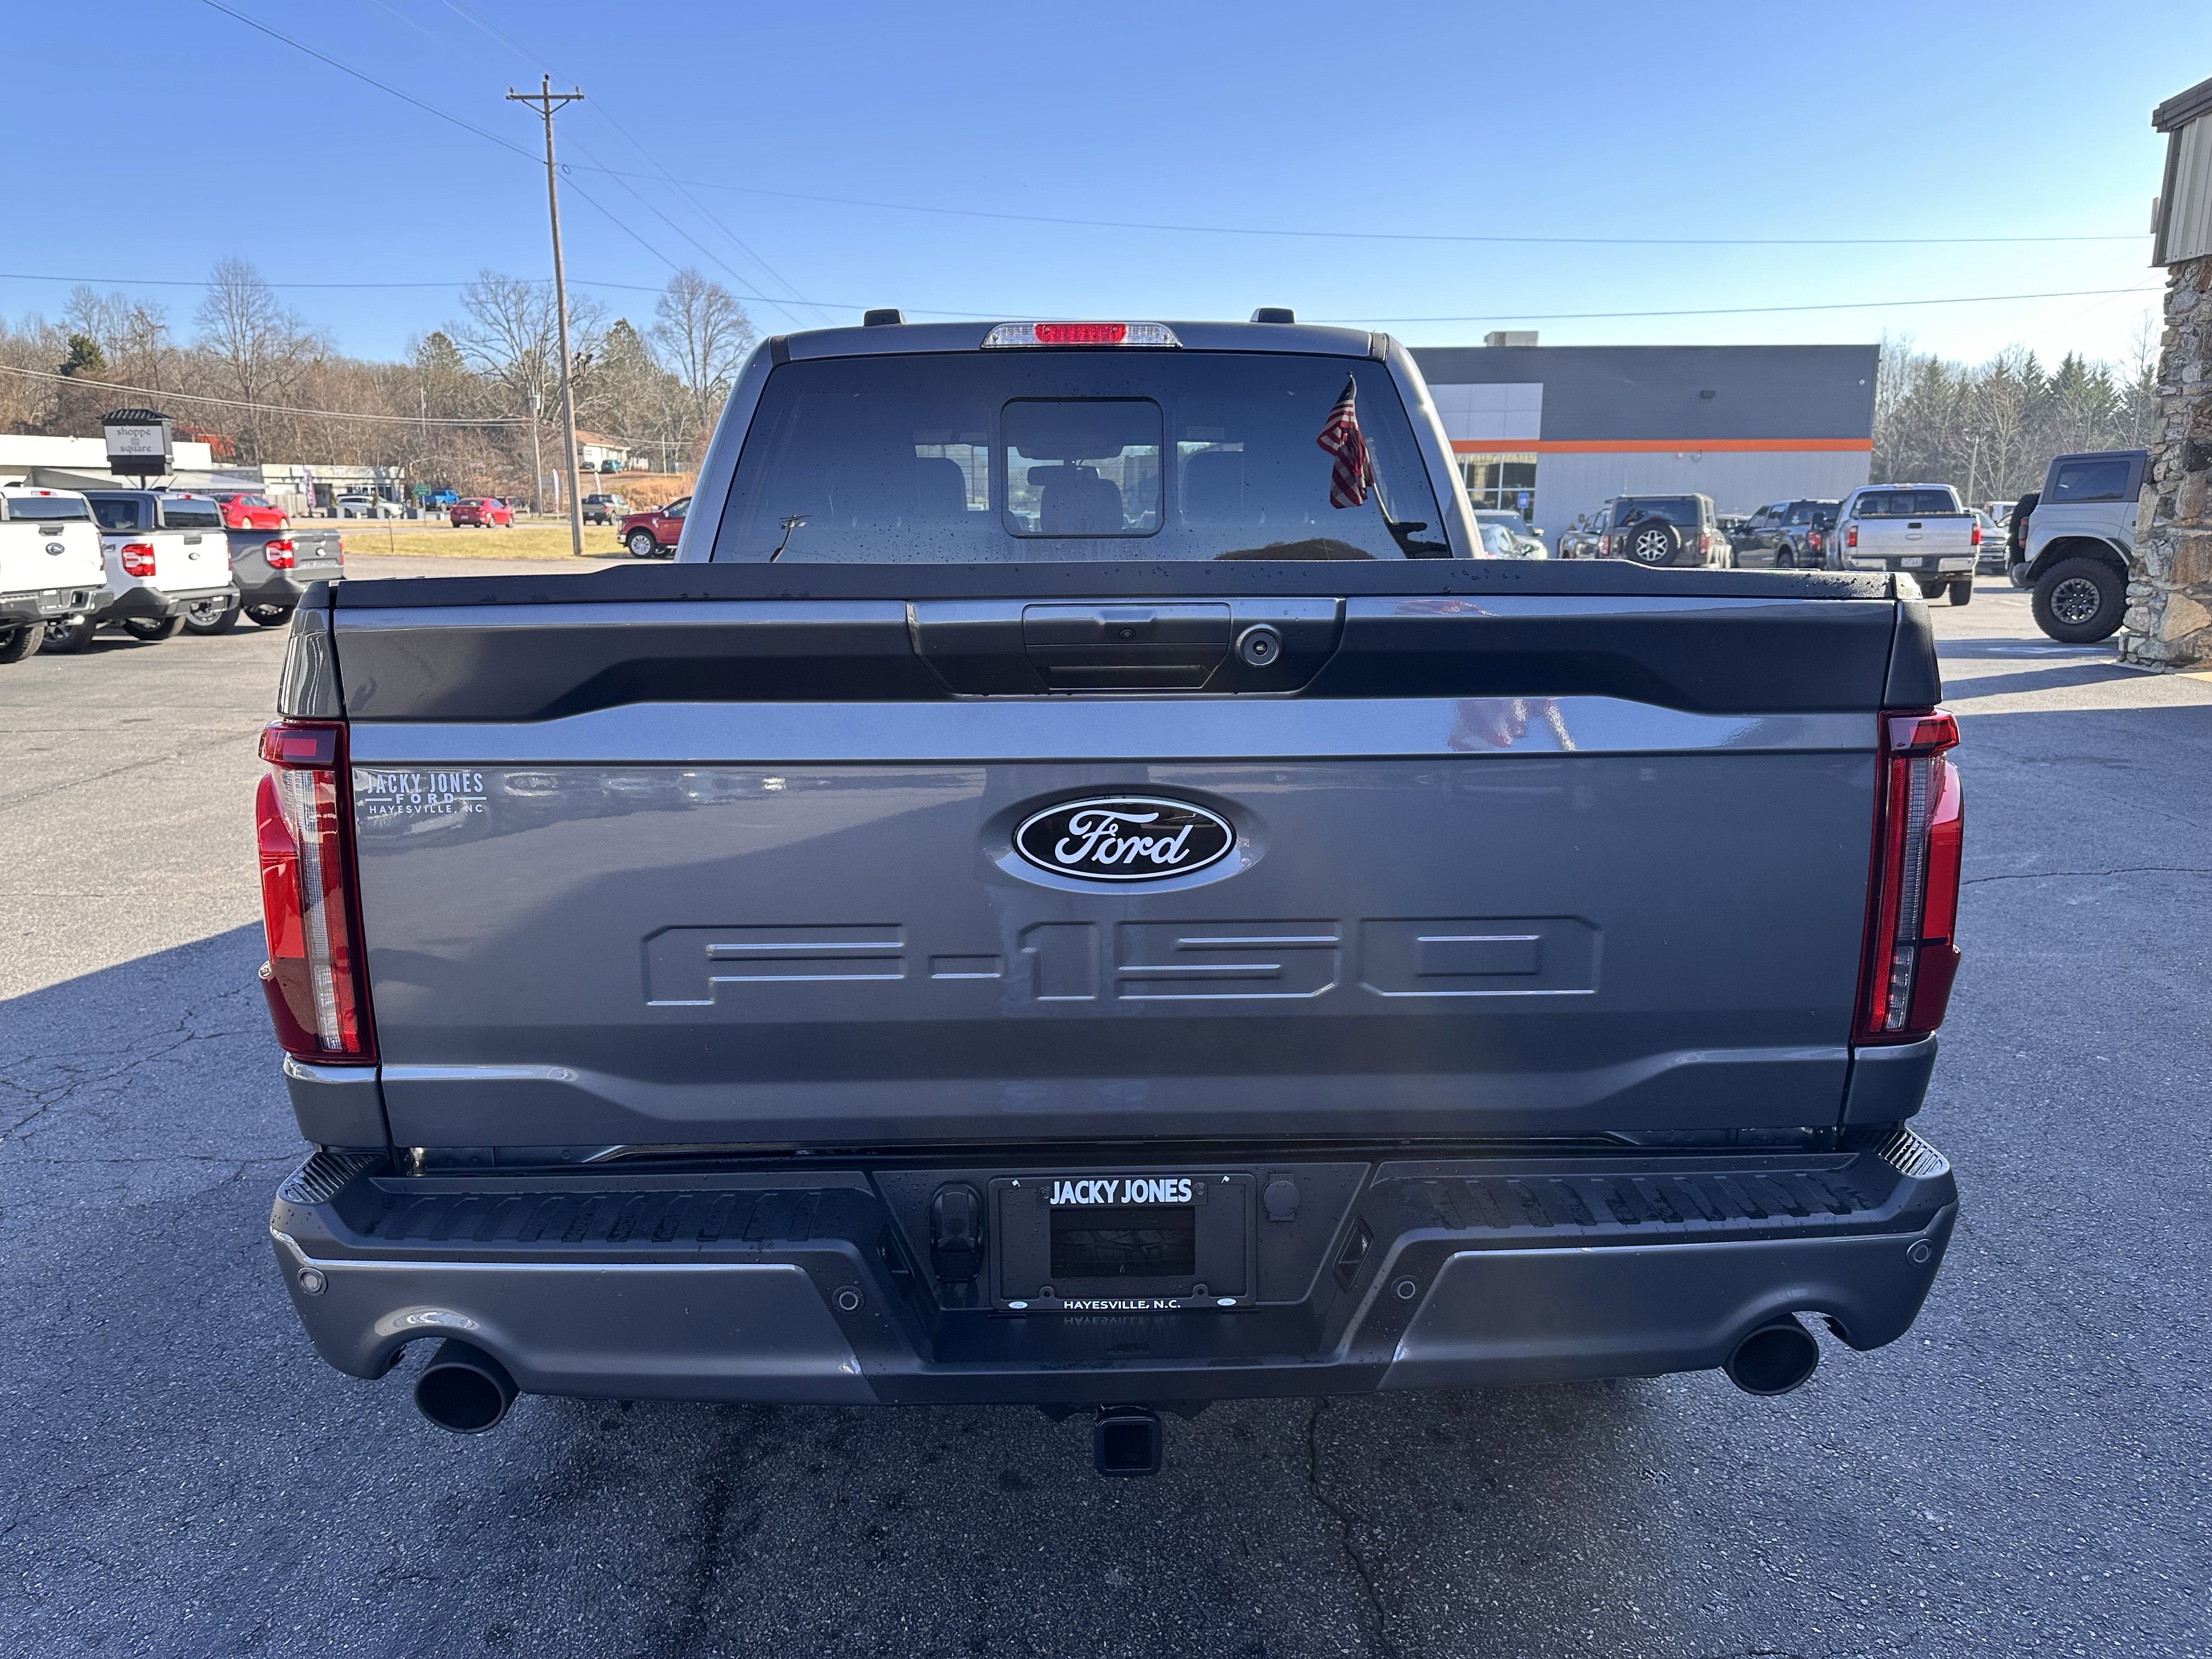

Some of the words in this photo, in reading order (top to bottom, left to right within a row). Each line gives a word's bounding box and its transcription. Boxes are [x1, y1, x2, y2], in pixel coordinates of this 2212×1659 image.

[117, 427, 151, 437] shoppe
[120, 445, 151, 454] square
[367, 774, 420, 794] JACKY
[430, 773, 483, 793] JONES
[396, 793, 454, 804] FORD
[369, 804, 458, 814] HAYESVILLE,
[466, 804, 483, 813] NC
[1054, 810, 1194, 864] Ford
[641, 916, 1602, 1006] F-150
[1050, 1180, 1119, 1204] JACKY
[1121, 1178, 1192, 1204] JONES
[1064, 1301, 1150, 1310] HAYESVILLE,
[1154, 1300, 1181, 1308] N.C.
